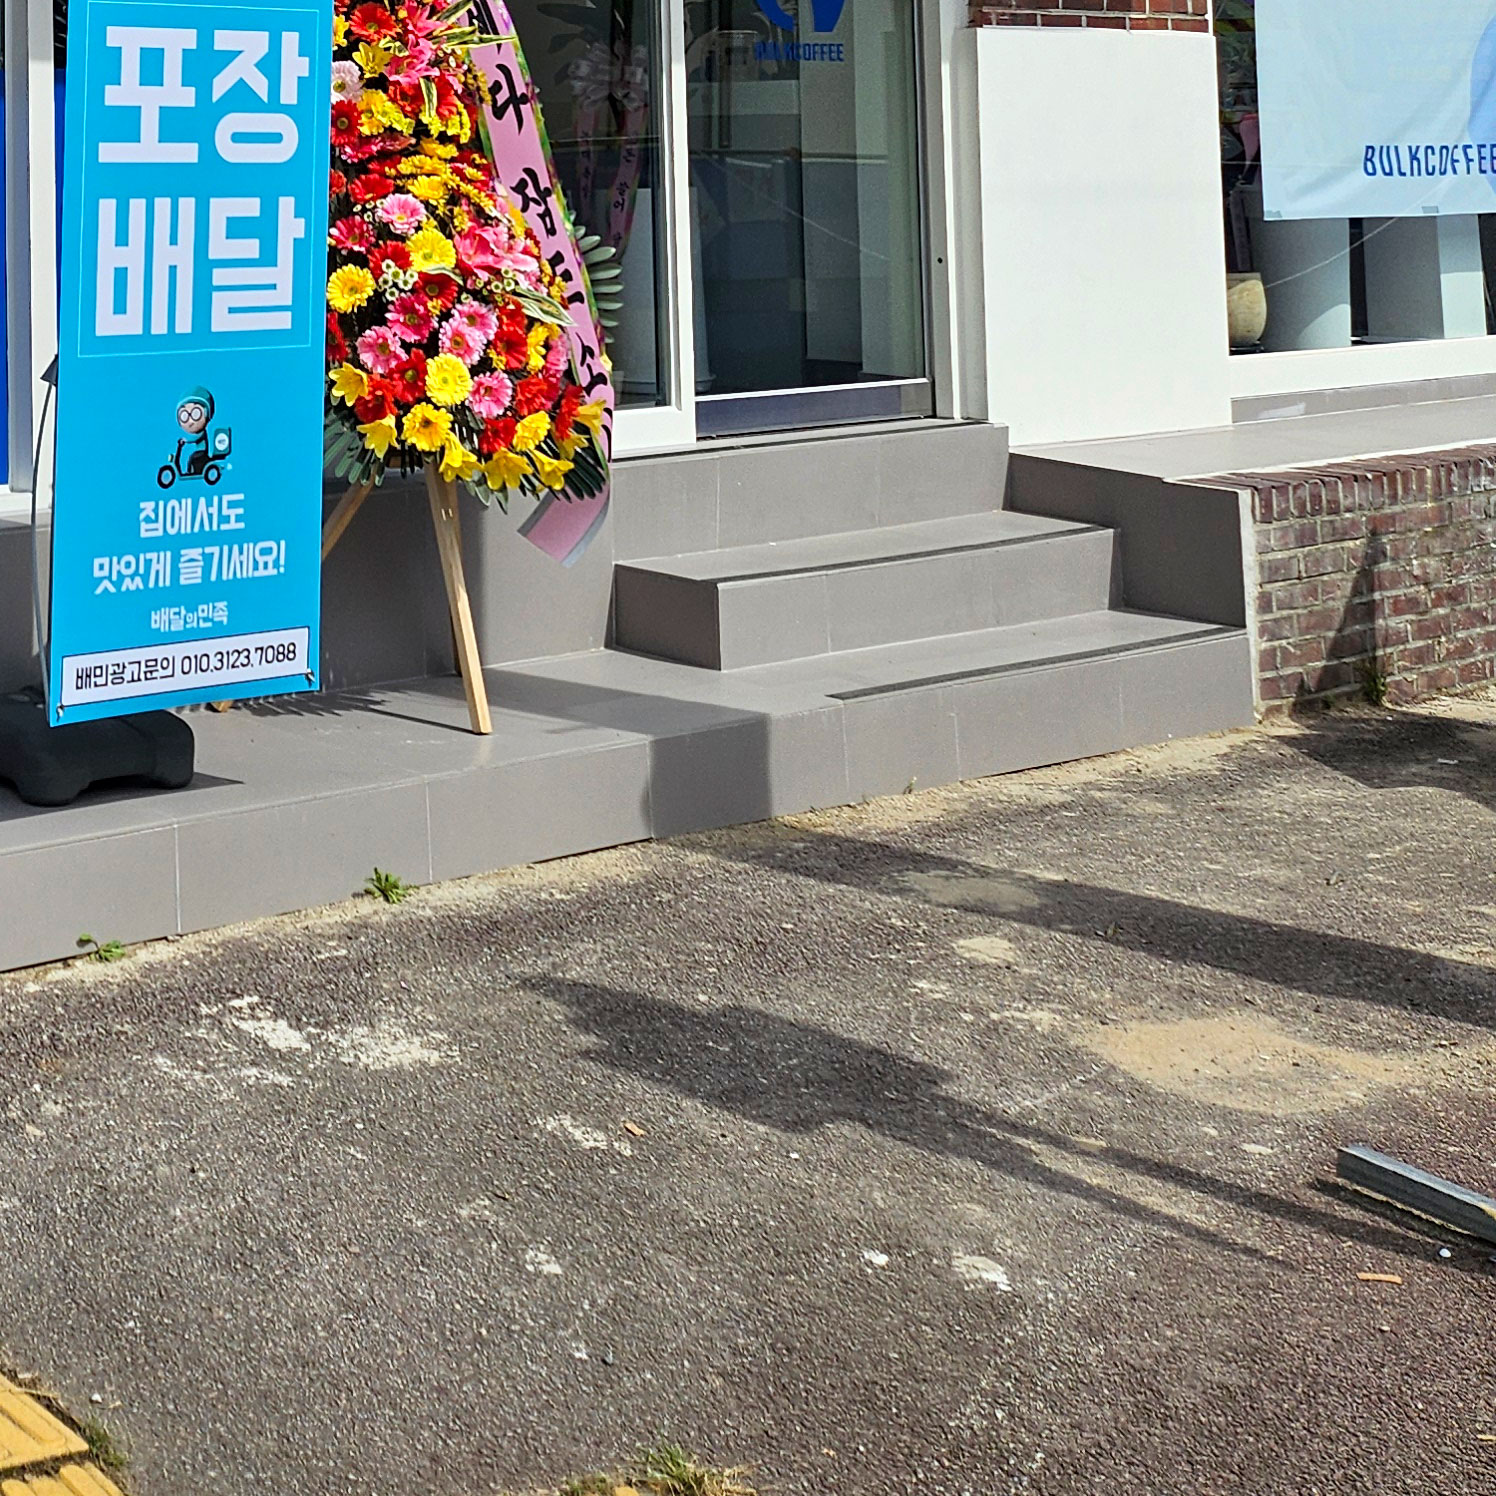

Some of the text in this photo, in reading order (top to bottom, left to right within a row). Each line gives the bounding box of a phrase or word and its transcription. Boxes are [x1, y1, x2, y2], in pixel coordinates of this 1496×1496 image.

[98, 25, 310, 164] 포장
[95, 196, 305, 337] 배달
[138, 493, 245, 538] 집에서도
[93, 539, 287, 596] 맛있게 즐기세요!
[150, 601, 228, 633] 배달의민족
[75, 642, 297, 691] 배민광고문의 010.3123.7088
